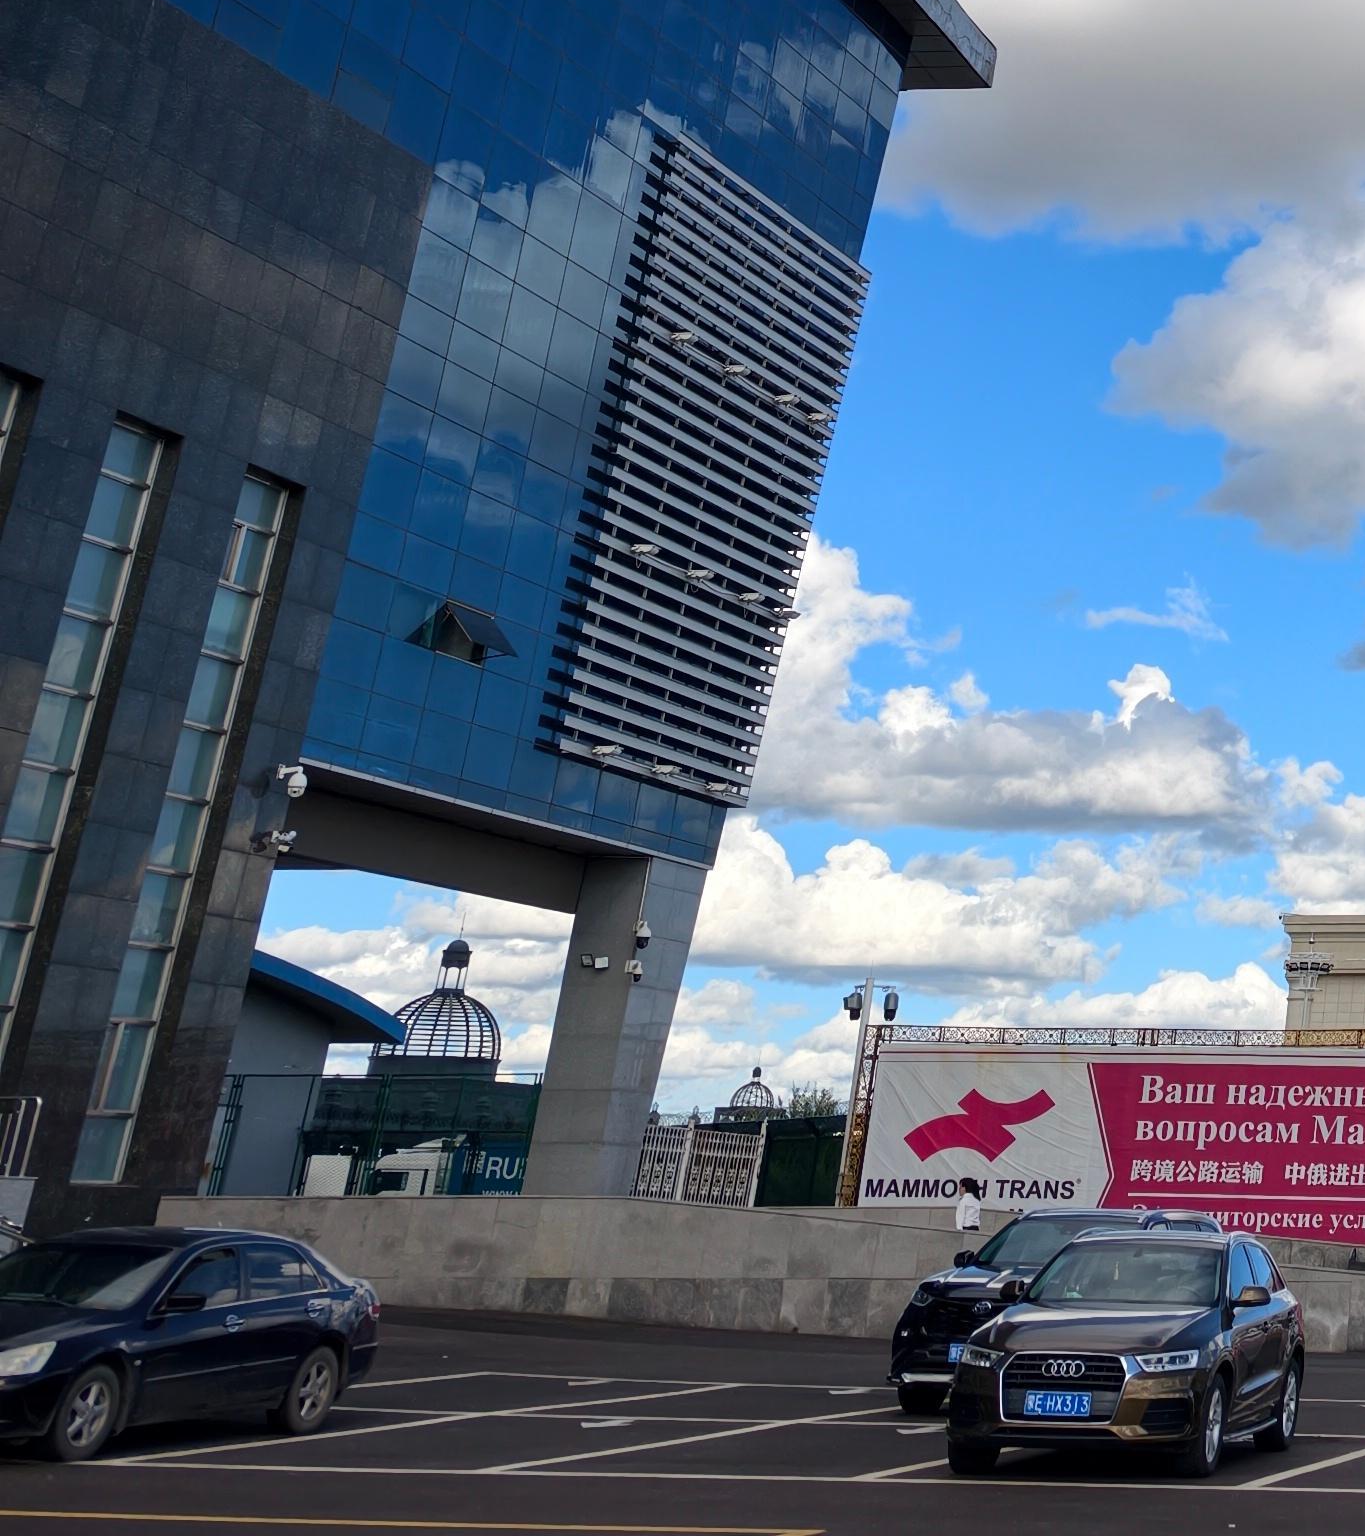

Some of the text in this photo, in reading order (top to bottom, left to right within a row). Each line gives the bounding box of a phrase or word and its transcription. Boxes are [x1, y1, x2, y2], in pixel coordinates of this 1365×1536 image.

[1138, 1075, 1215, 1105] Ваш
[1134, 1120, 1300, 1150] вопросам
[1130, 1159, 1264, 1184] 跨境公路运输
[864, 1178, 1075, 1199] MAMMOH TRANS
